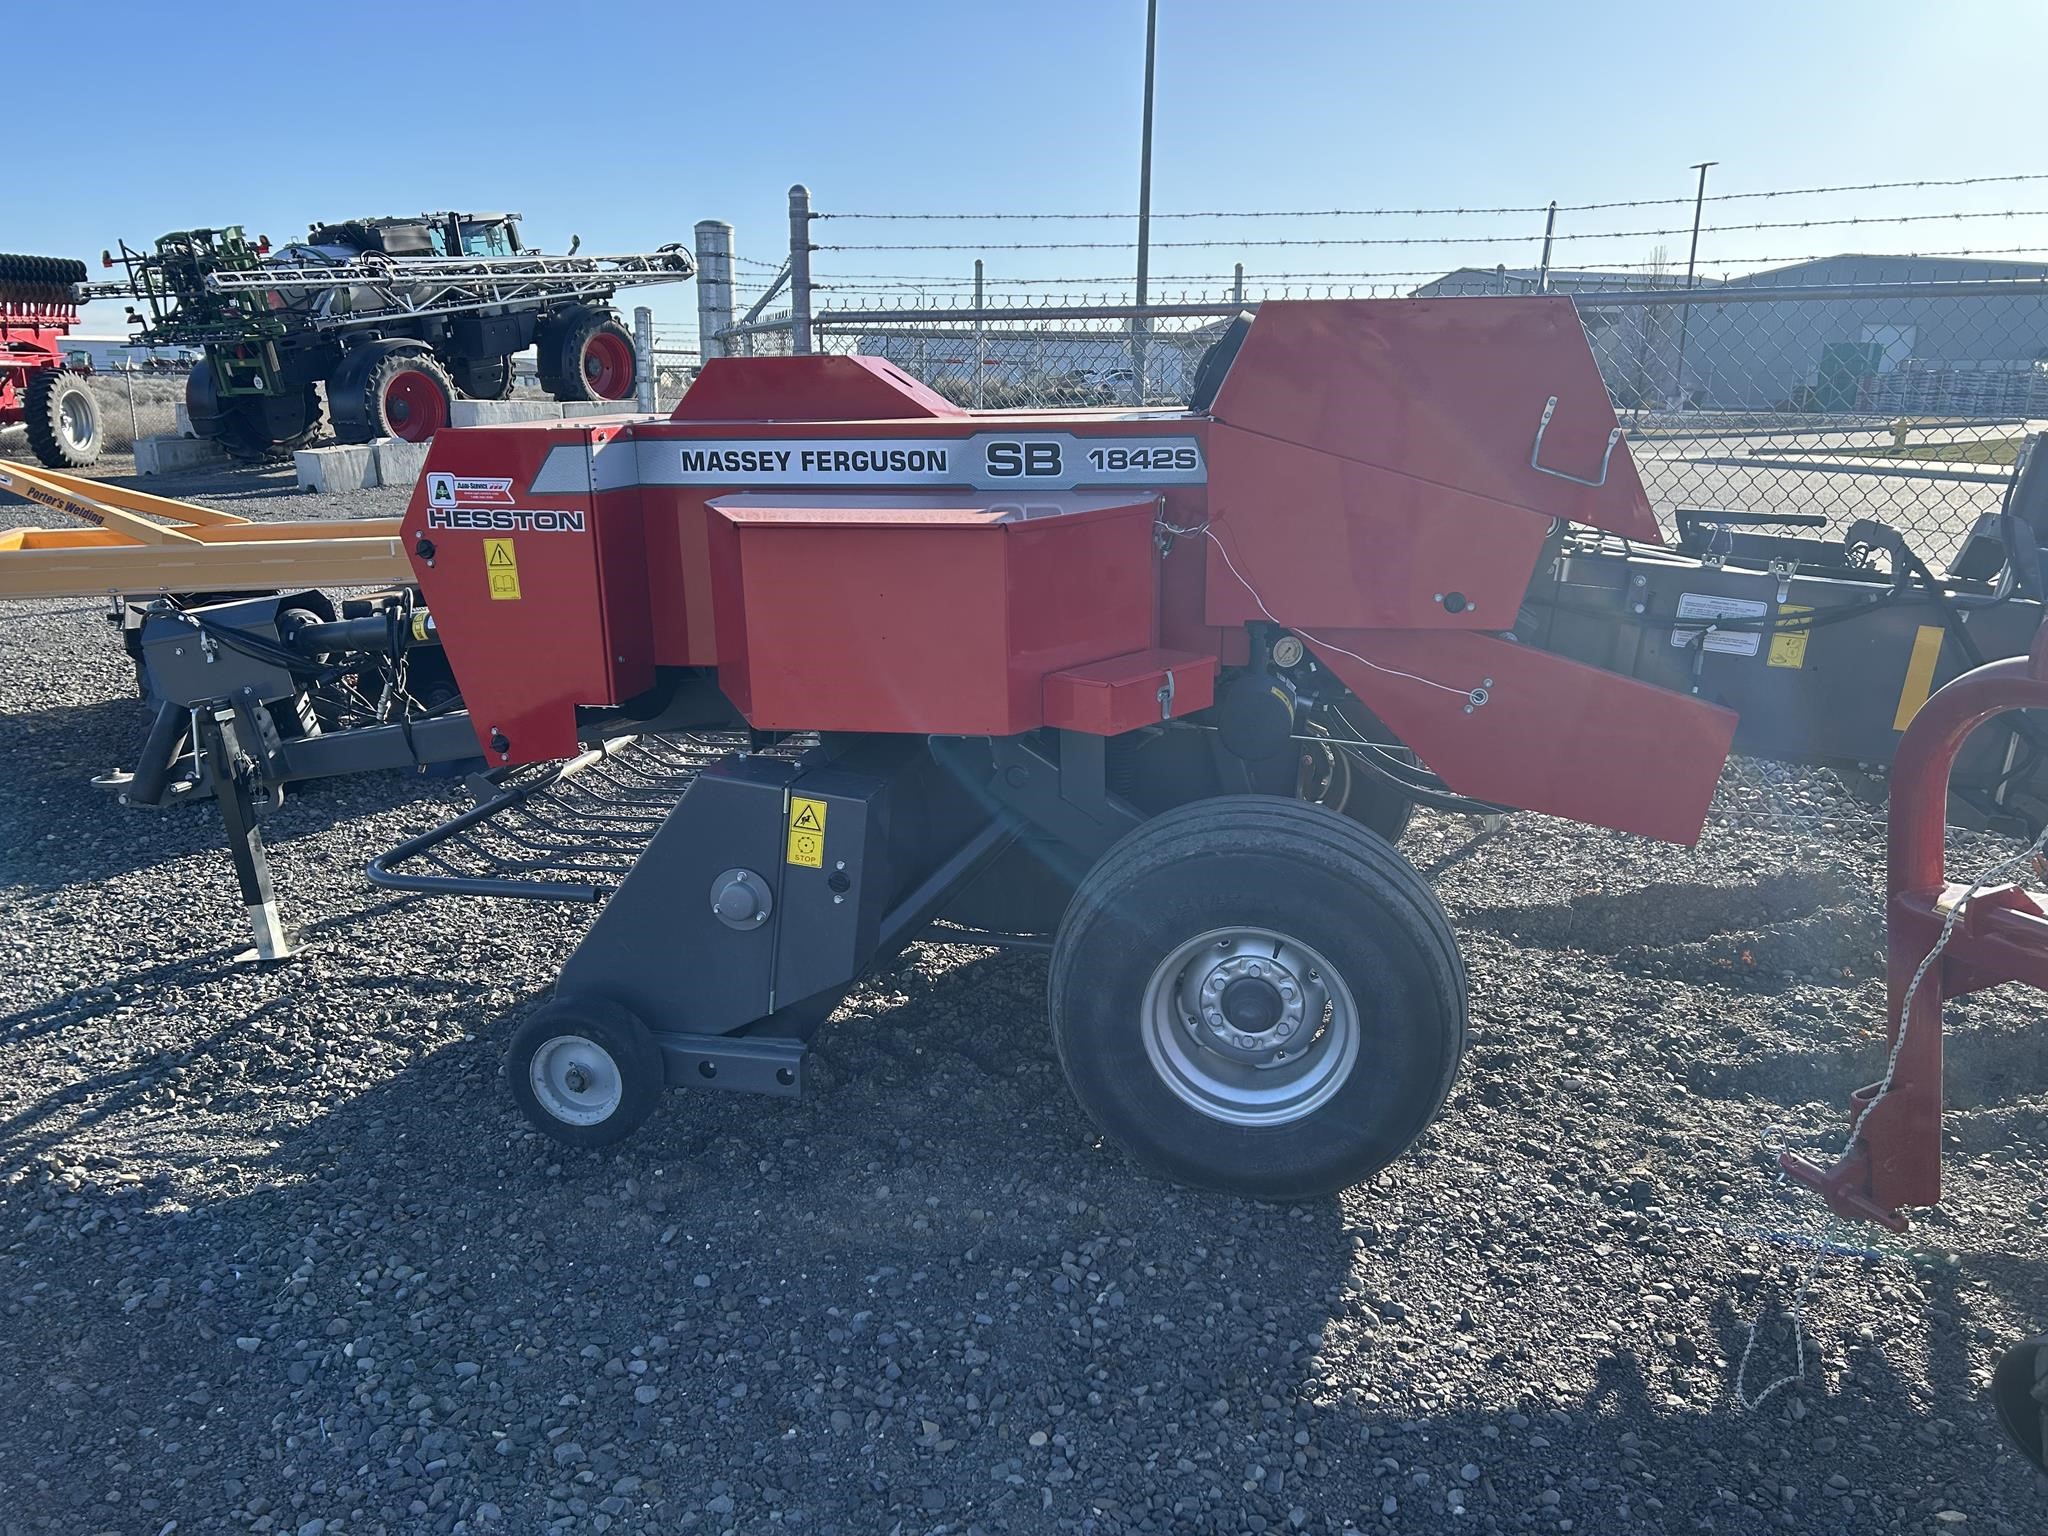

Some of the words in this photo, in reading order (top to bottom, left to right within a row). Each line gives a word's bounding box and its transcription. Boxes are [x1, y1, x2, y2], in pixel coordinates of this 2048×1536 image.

[681, 450, 792, 473] MASSEY
[800, 449, 948, 473] FERGUSON
[986, 441, 1063, 477] SB
[1088, 448, 1197, 471] 1842S
[26, 486, 65, 509] Porter's
[64, 501, 105, 526] Welding
[428, 510, 584, 531] HESSTON
[794, 853, 816, 863] STOP
